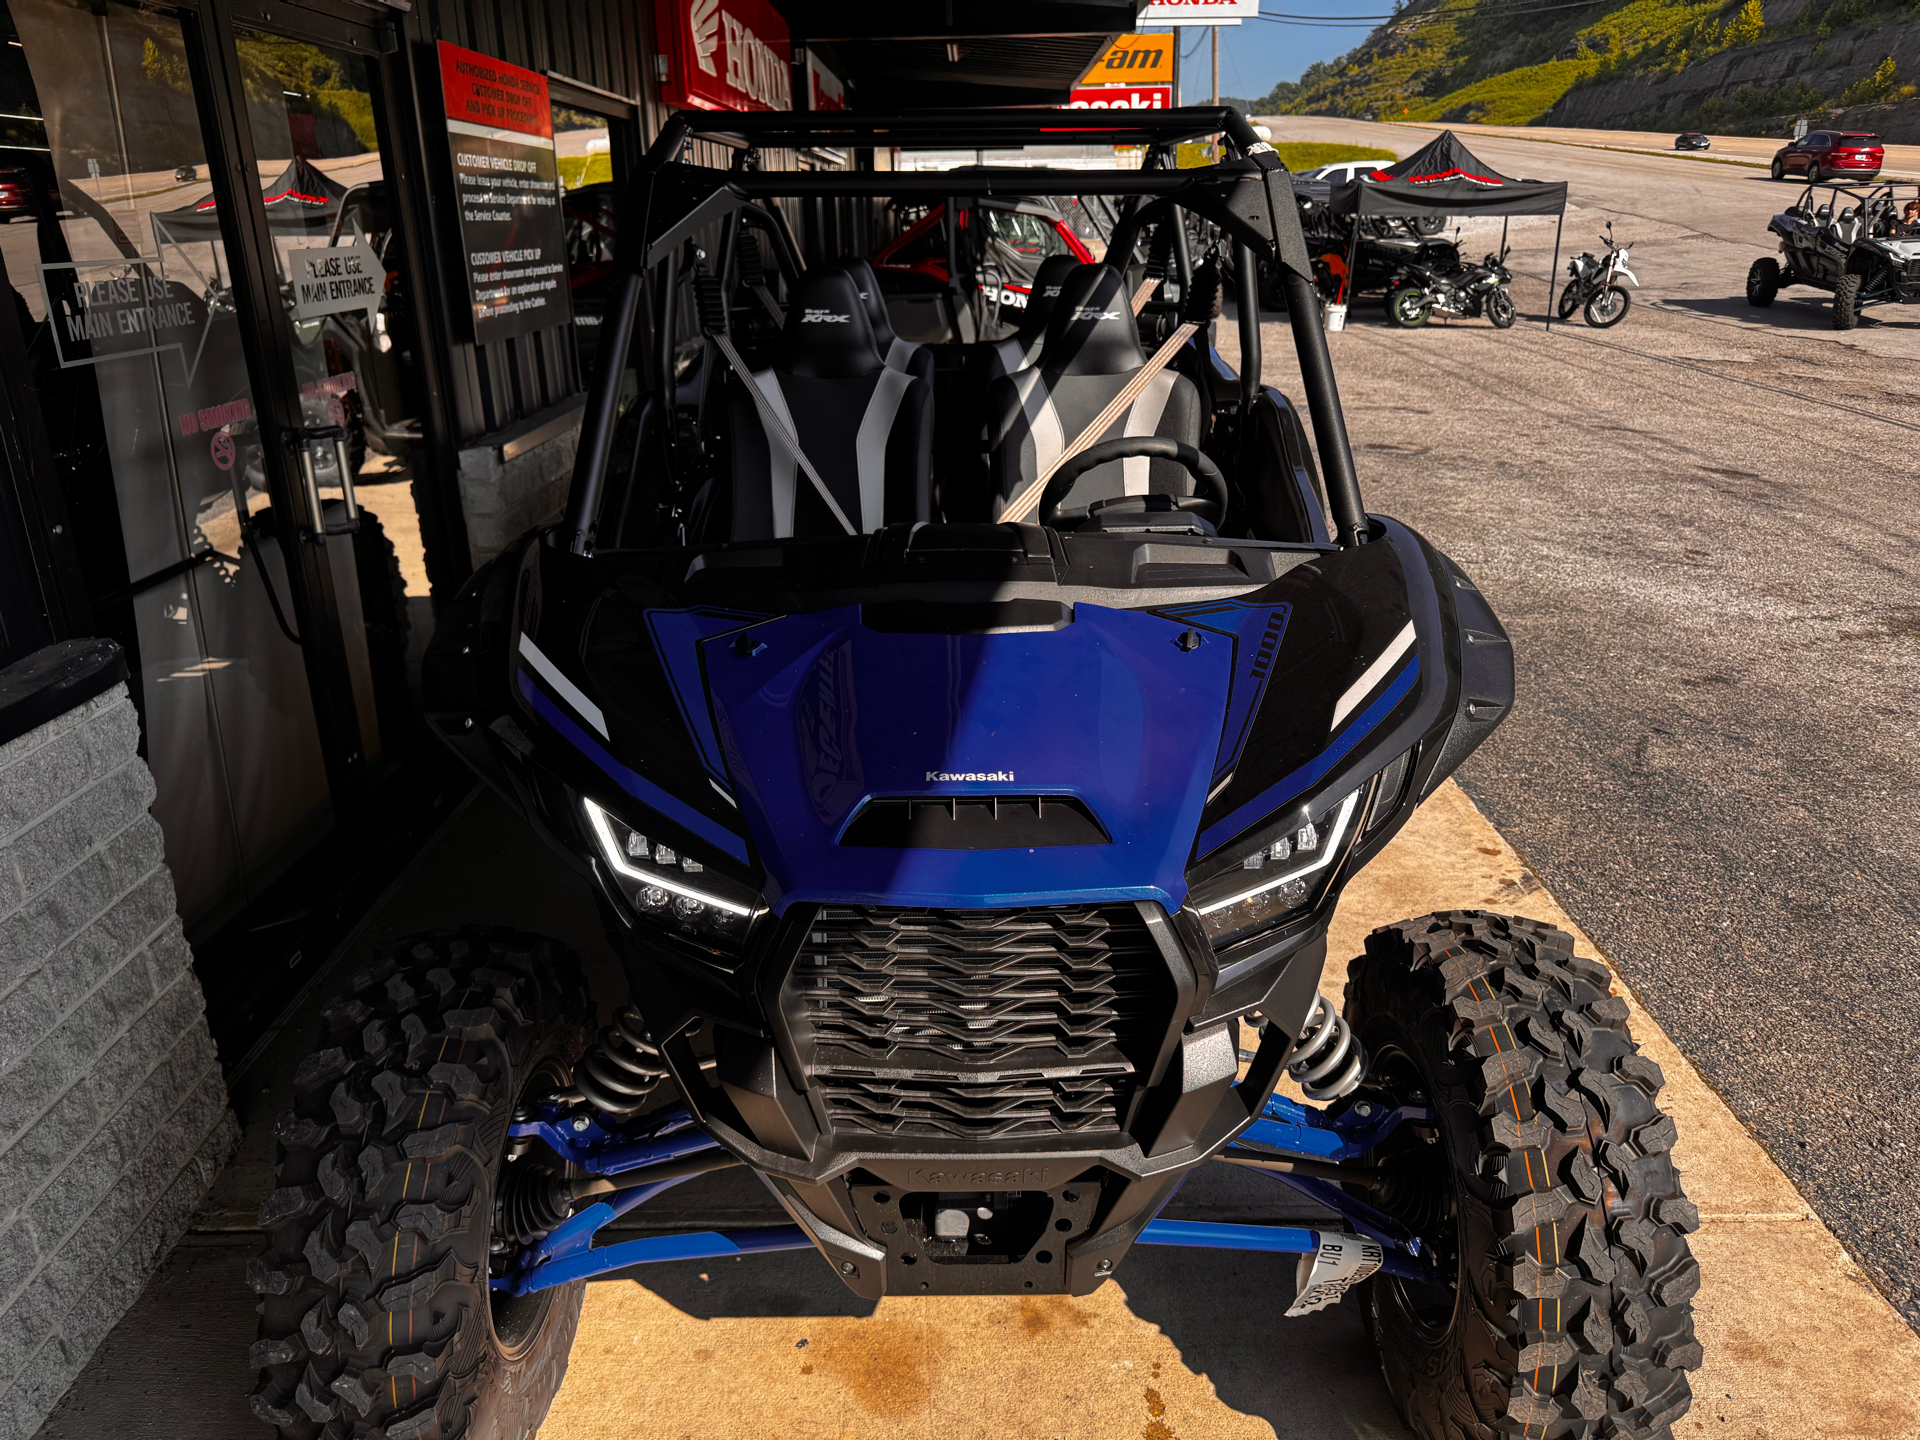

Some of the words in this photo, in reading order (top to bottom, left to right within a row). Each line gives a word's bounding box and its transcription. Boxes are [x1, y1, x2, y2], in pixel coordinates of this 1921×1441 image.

[722, 9, 793, 111] HONDA
[456, 60, 497, 82] AUTHORIZED
[472, 82, 504, 102] CUSTOMER
[466, 100, 480, 114] AND
[497, 106, 505, 118] UP
[456, 153, 490, 169] CUSTOMER
[490, 157, 512, 171] VEHICLE
[513, 160, 527, 173] DROP
[528, 162, 537, 174] OFF
[459, 173, 476, 186] Please
[474, 210, 492, 222] Service
[306, 257, 342, 279] PLEASE
[344, 255, 363, 275] USE
[470, 251, 502, 266] CUSTOMER
[502, 249, 524, 263] VEHICLE
[524, 248, 534, 260] PICK
[534, 248, 542, 260] UP
[74, 278, 140, 308] PLEASE
[147, 274, 174, 300] USE
[301, 281, 328, 304] MAIN
[328, 276, 376, 300] ENTRANCE
[983, 285, 1028, 309] HON
[66, 309, 114, 342] MAIN
[116, 302, 196, 335] ENTRANCE
[801, 314, 850, 323] KRX
[1070, 312, 1121, 320] KRX
[179, 412, 199, 436] NO
[198, 398, 252, 432] SMOKING
[1250, 612, 1284, 678] 1000
[926, 770, 1014, 782] Kawasaki
[908, 1167, 1050, 1186] Kawasaki
